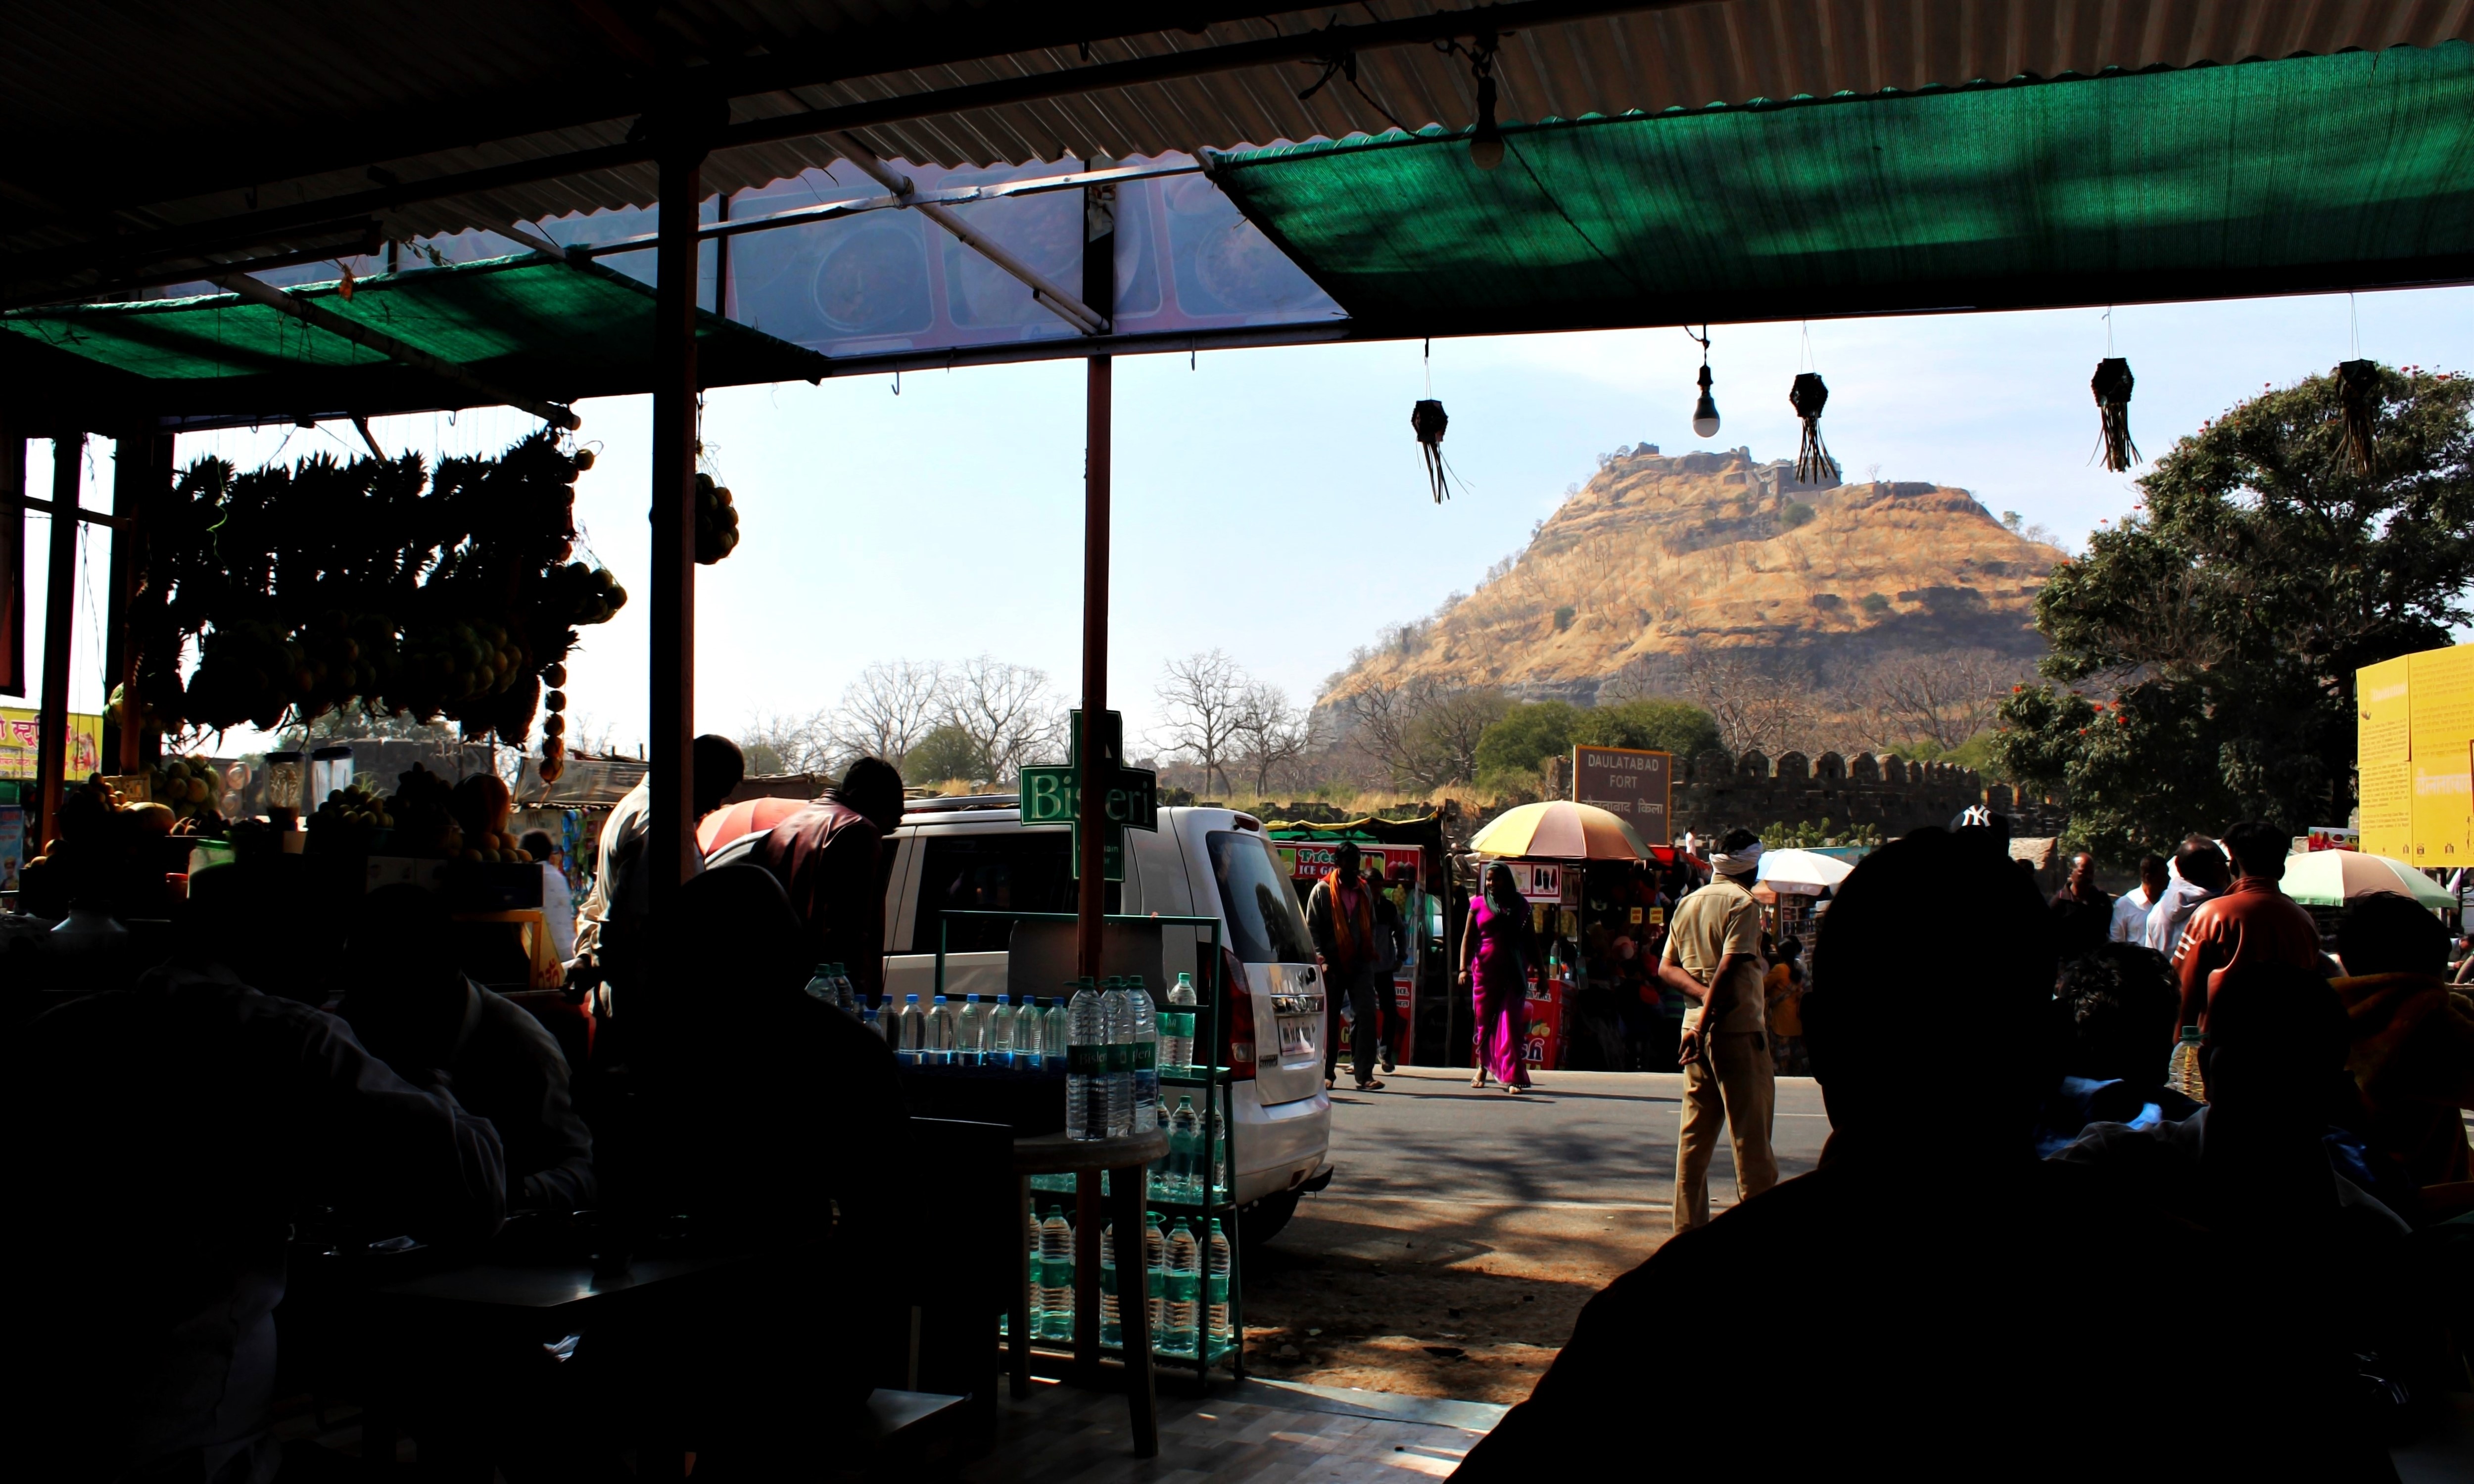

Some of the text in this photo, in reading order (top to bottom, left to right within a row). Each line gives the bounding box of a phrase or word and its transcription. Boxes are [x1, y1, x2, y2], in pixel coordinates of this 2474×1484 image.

[1588, 754, 1659, 771] DAULATABAD
[1610, 775, 1637, 788] FORT
[1031, 775, 1151, 824] Bieri
[1638, 798, 1664, 814] किला
[1961, 804, 1992, 828] NY
[1299, 865, 1316, 875] ICE
